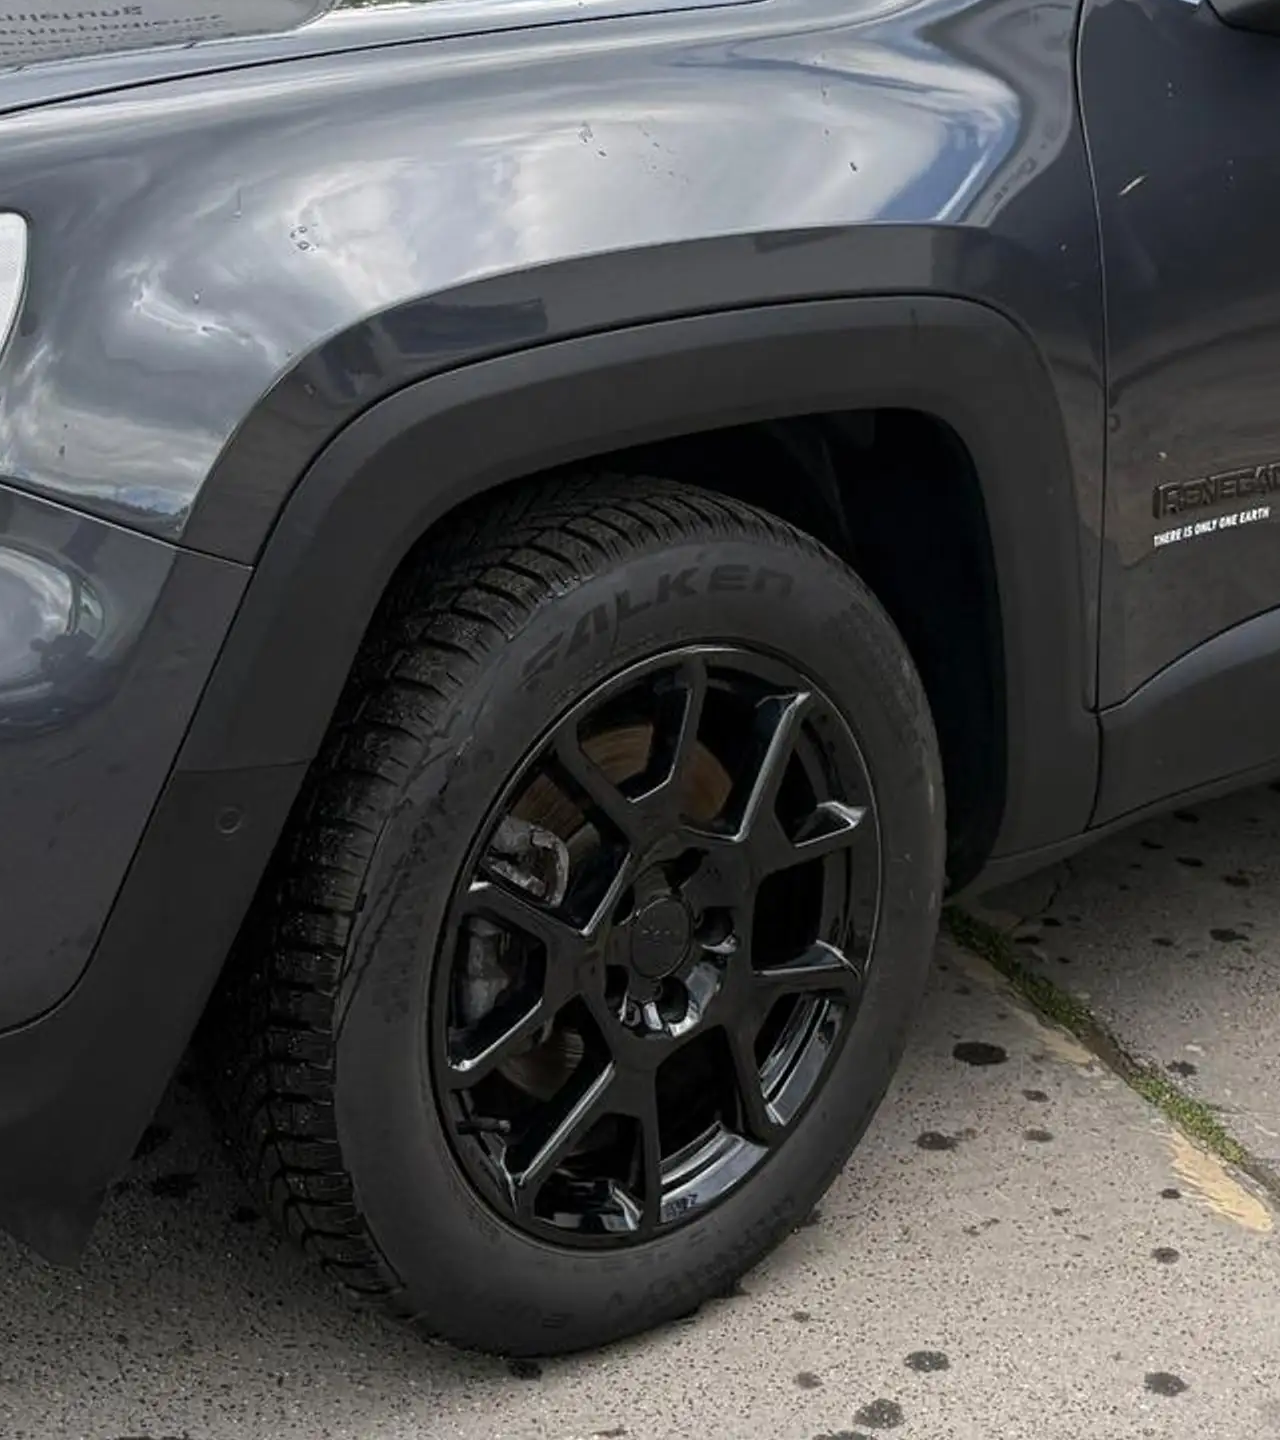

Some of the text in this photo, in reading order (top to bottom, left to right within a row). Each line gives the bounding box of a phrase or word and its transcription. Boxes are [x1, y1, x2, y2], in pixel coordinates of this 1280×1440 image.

[1153, 506, 1271, 548] THERE IS ONLY ONE EARTH
[516, 563, 795, 692] FALKEN
